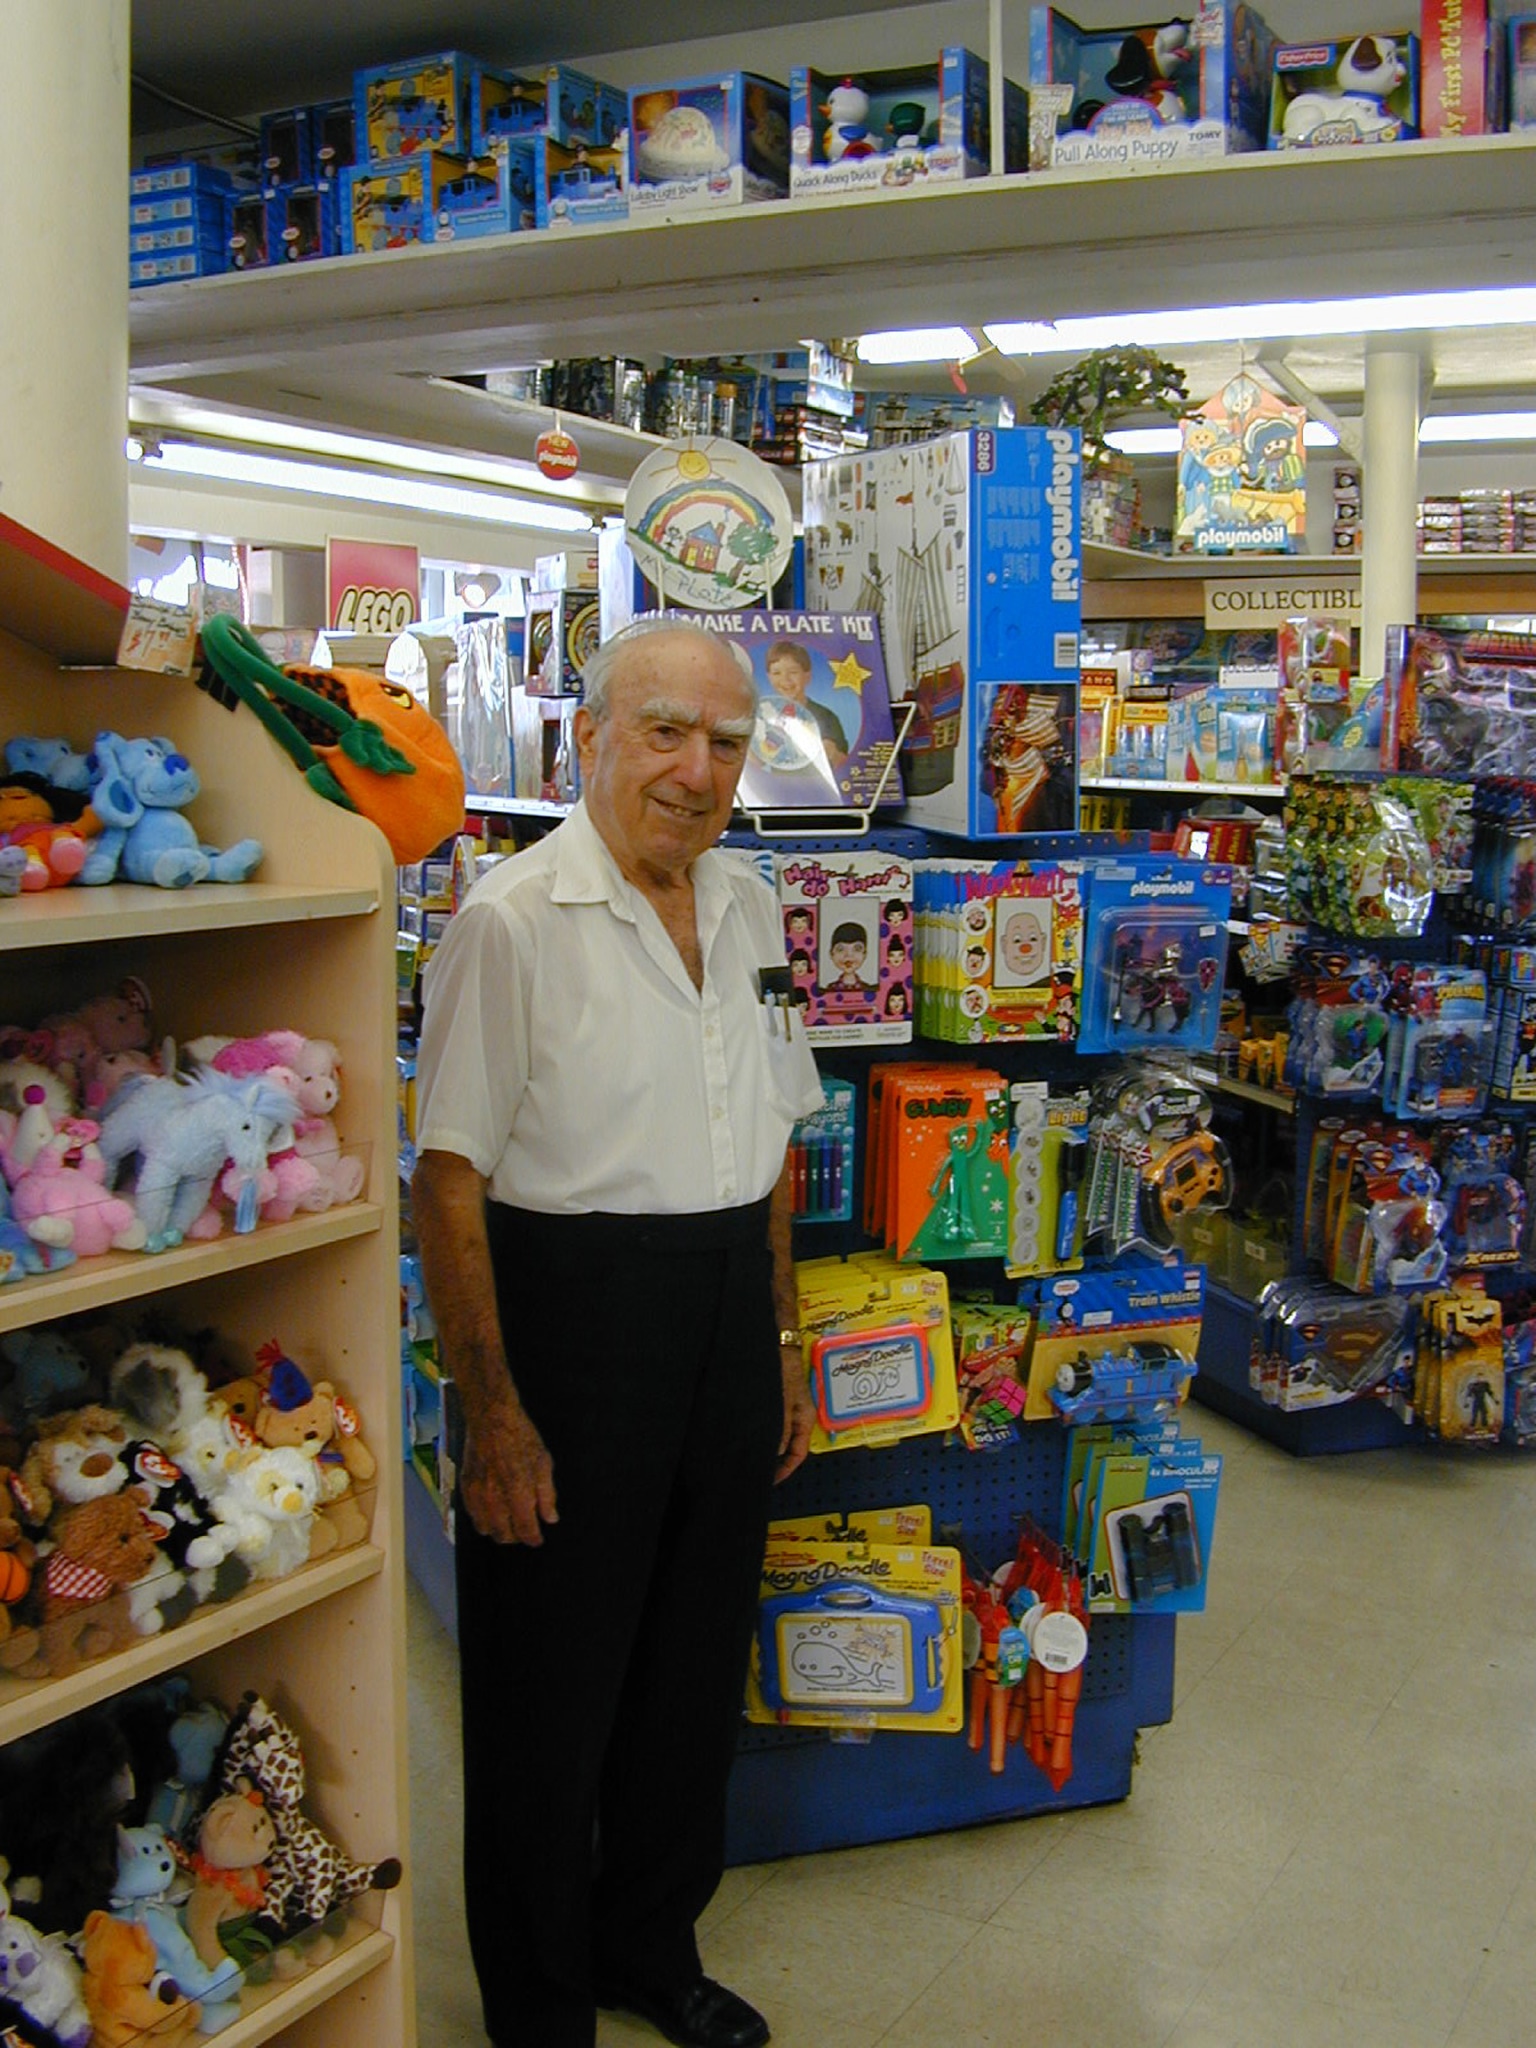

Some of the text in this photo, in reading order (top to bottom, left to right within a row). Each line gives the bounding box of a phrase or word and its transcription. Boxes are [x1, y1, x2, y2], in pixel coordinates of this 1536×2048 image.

[1187, 130, 1222, 142] TOMY
[1055, 139, 1179, 163] Pull Along Puppy
[823, 172, 849, 186] Along
[976, 431, 991, 472] 3286
[1044, 429, 1080, 601] playmobil
[1197, 526, 1285, 549] playmobil
[335, 585, 415, 635] LEGO
[1211, 588, 1362, 611] COLLECTIBL
[681, 614, 873, 634] MAKE A PLATE KIT
[1129, 880, 1195, 897] playmobil
[904, 1097, 973, 1120] GUMBY
